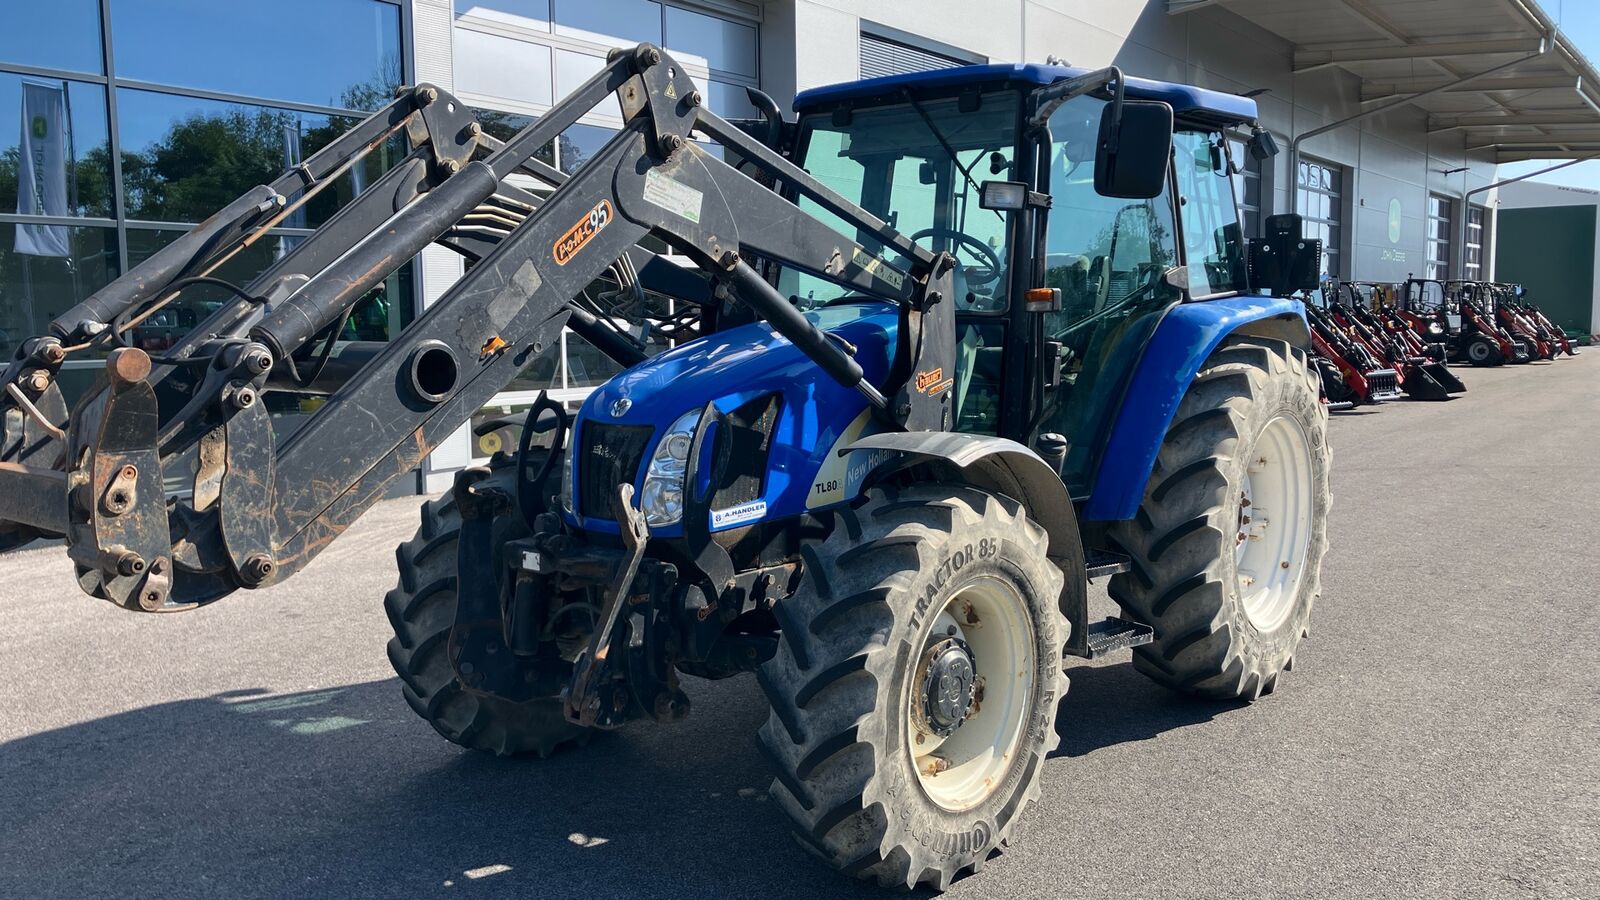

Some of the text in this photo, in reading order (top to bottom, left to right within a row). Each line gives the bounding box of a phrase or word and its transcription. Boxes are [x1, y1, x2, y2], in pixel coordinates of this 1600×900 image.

[590, 201, 607, 234] 95
[847, 448, 896, 486] New Hollan
[907, 536, 998, 631] TRACTOR 85
[1043, 690, 1056, 704] R
[1035, 716, 1051, 745] 24
